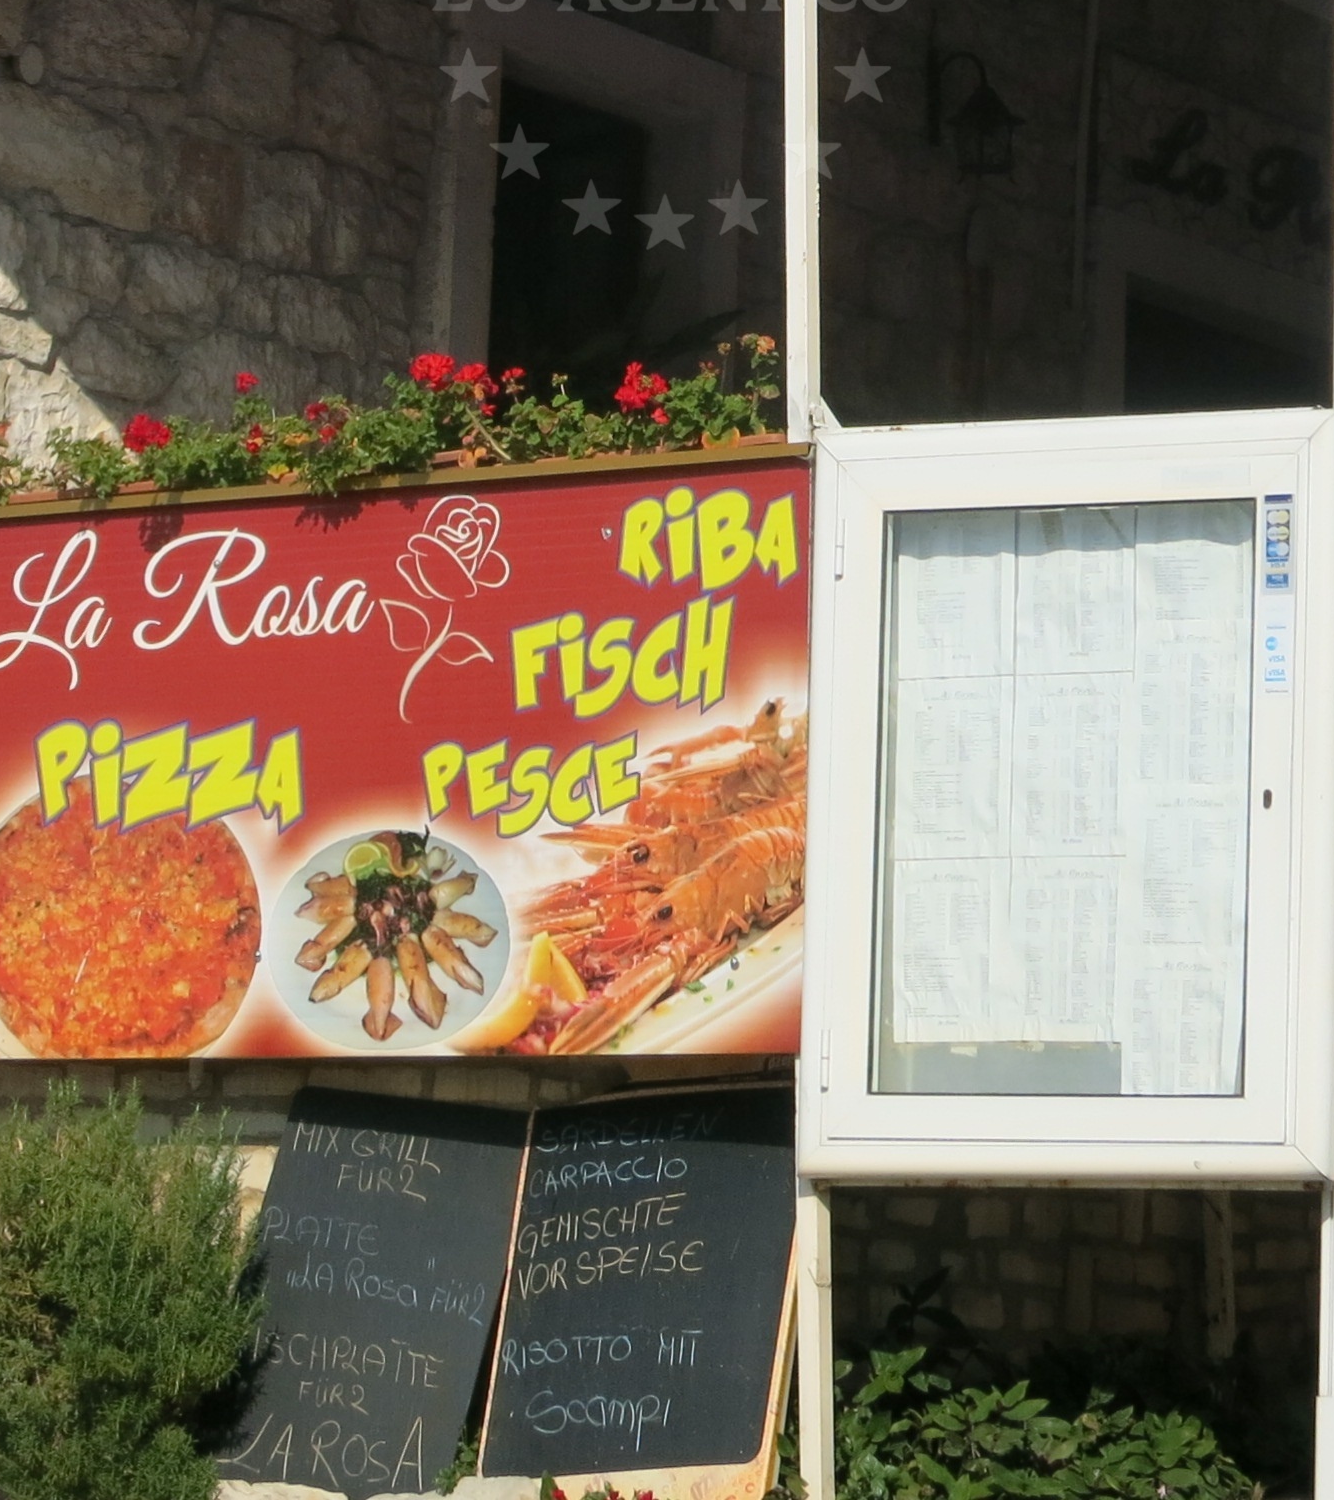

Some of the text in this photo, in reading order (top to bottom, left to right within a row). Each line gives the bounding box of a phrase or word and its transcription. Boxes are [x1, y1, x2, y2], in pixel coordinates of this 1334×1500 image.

[132, 527, 379, 653] Rosa
[1268, 654, 1285, 663] VISA
[421, 728, 643, 840] PESCE
[292, 1121, 441, 1175] MIX GRILL
[528, 1155, 688, 1199] CARPACCIO
[263, 1205, 379, 1256] PLATTE
[252, 1326, 444, 1389] ISCHPLATTE
[501, 1334, 633, 1377] RISOTTO
[215, 1412, 424, 1493] LA ROSA
